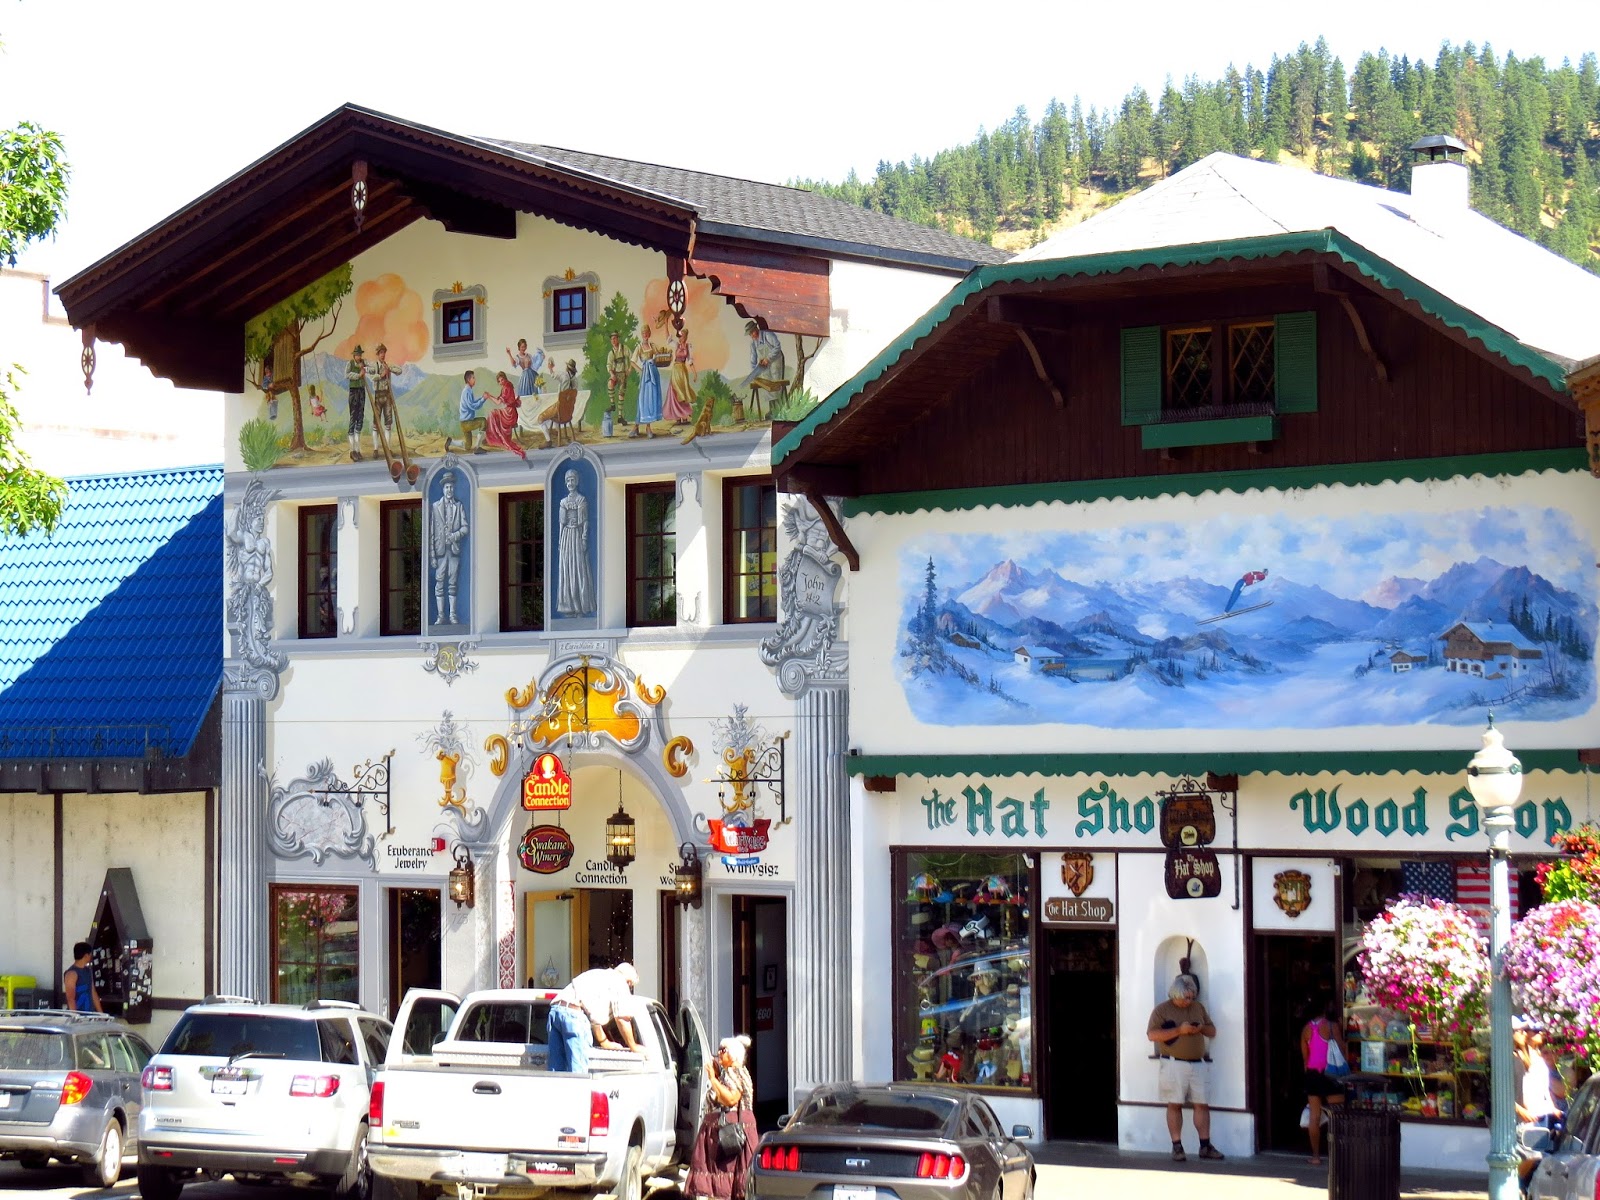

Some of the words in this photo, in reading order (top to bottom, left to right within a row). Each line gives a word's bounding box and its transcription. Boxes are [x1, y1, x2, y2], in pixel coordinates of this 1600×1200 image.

[802, 572, 824, 592] John
[526, 778, 569, 796] Candle
[525, 796, 569, 806] Connection
[961, 783, 1050, 838] Hat
[1075, 781, 1163, 838] Sho
[1289, 783, 1429, 837] Wood
[1445, 786, 1572, 847] Sop
[387, 845, 434, 857] Exuberance
[526, 837, 567, 856] Swakane
[395, 858, 428, 871] Jewelry
[532, 850, 565, 866] Winery
[1174, 859, 1190, 879] Hat
[1193, 858, 1214, 877] Shop
[575, 872, 628, 884] Connection
[1061, 900, 1078, 916] Hat
[1081, 900, 1107, 920] Shop
[757, 1008, 771, 1020] EGO
[845, 1158, 870, 1167] GT
